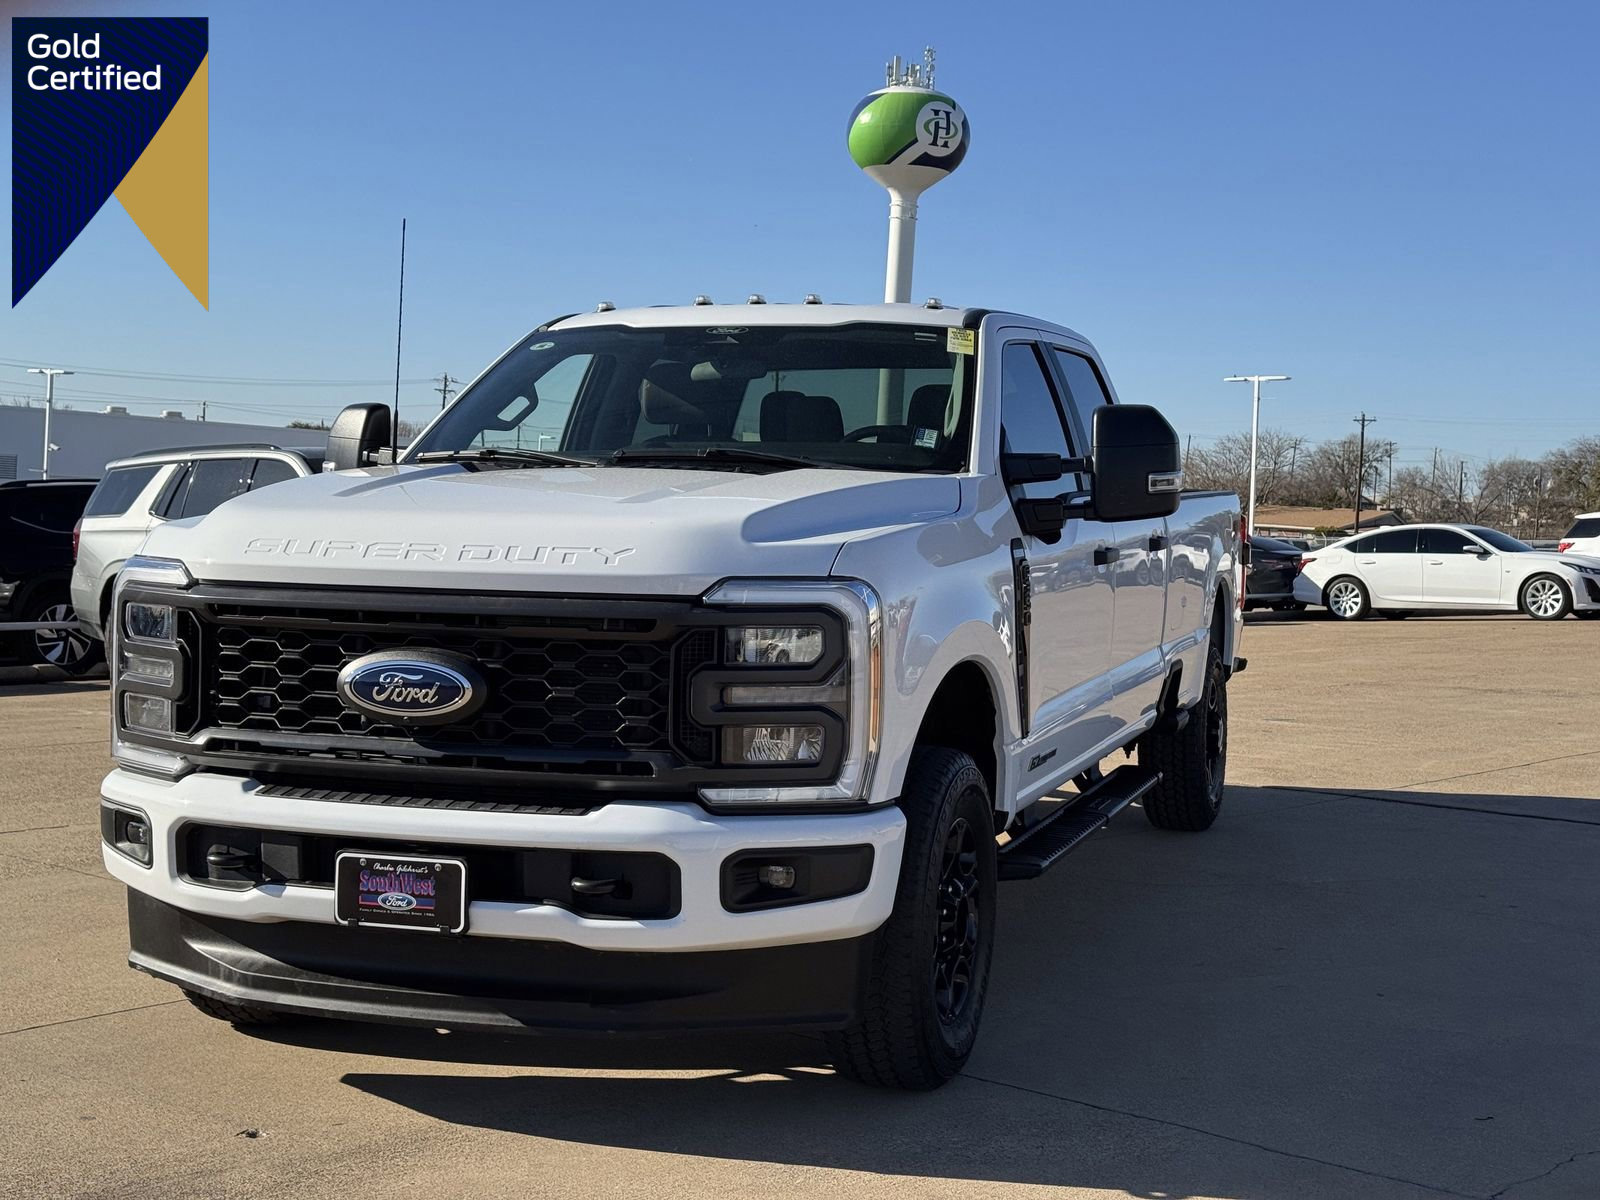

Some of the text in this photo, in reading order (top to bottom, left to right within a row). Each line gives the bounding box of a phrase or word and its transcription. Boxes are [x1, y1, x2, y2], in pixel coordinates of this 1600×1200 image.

[243, 537, 637, 566] SUPER DUTY
[372, 672, 439, 705] Ford
[385, 895, 408, 907] Ford
